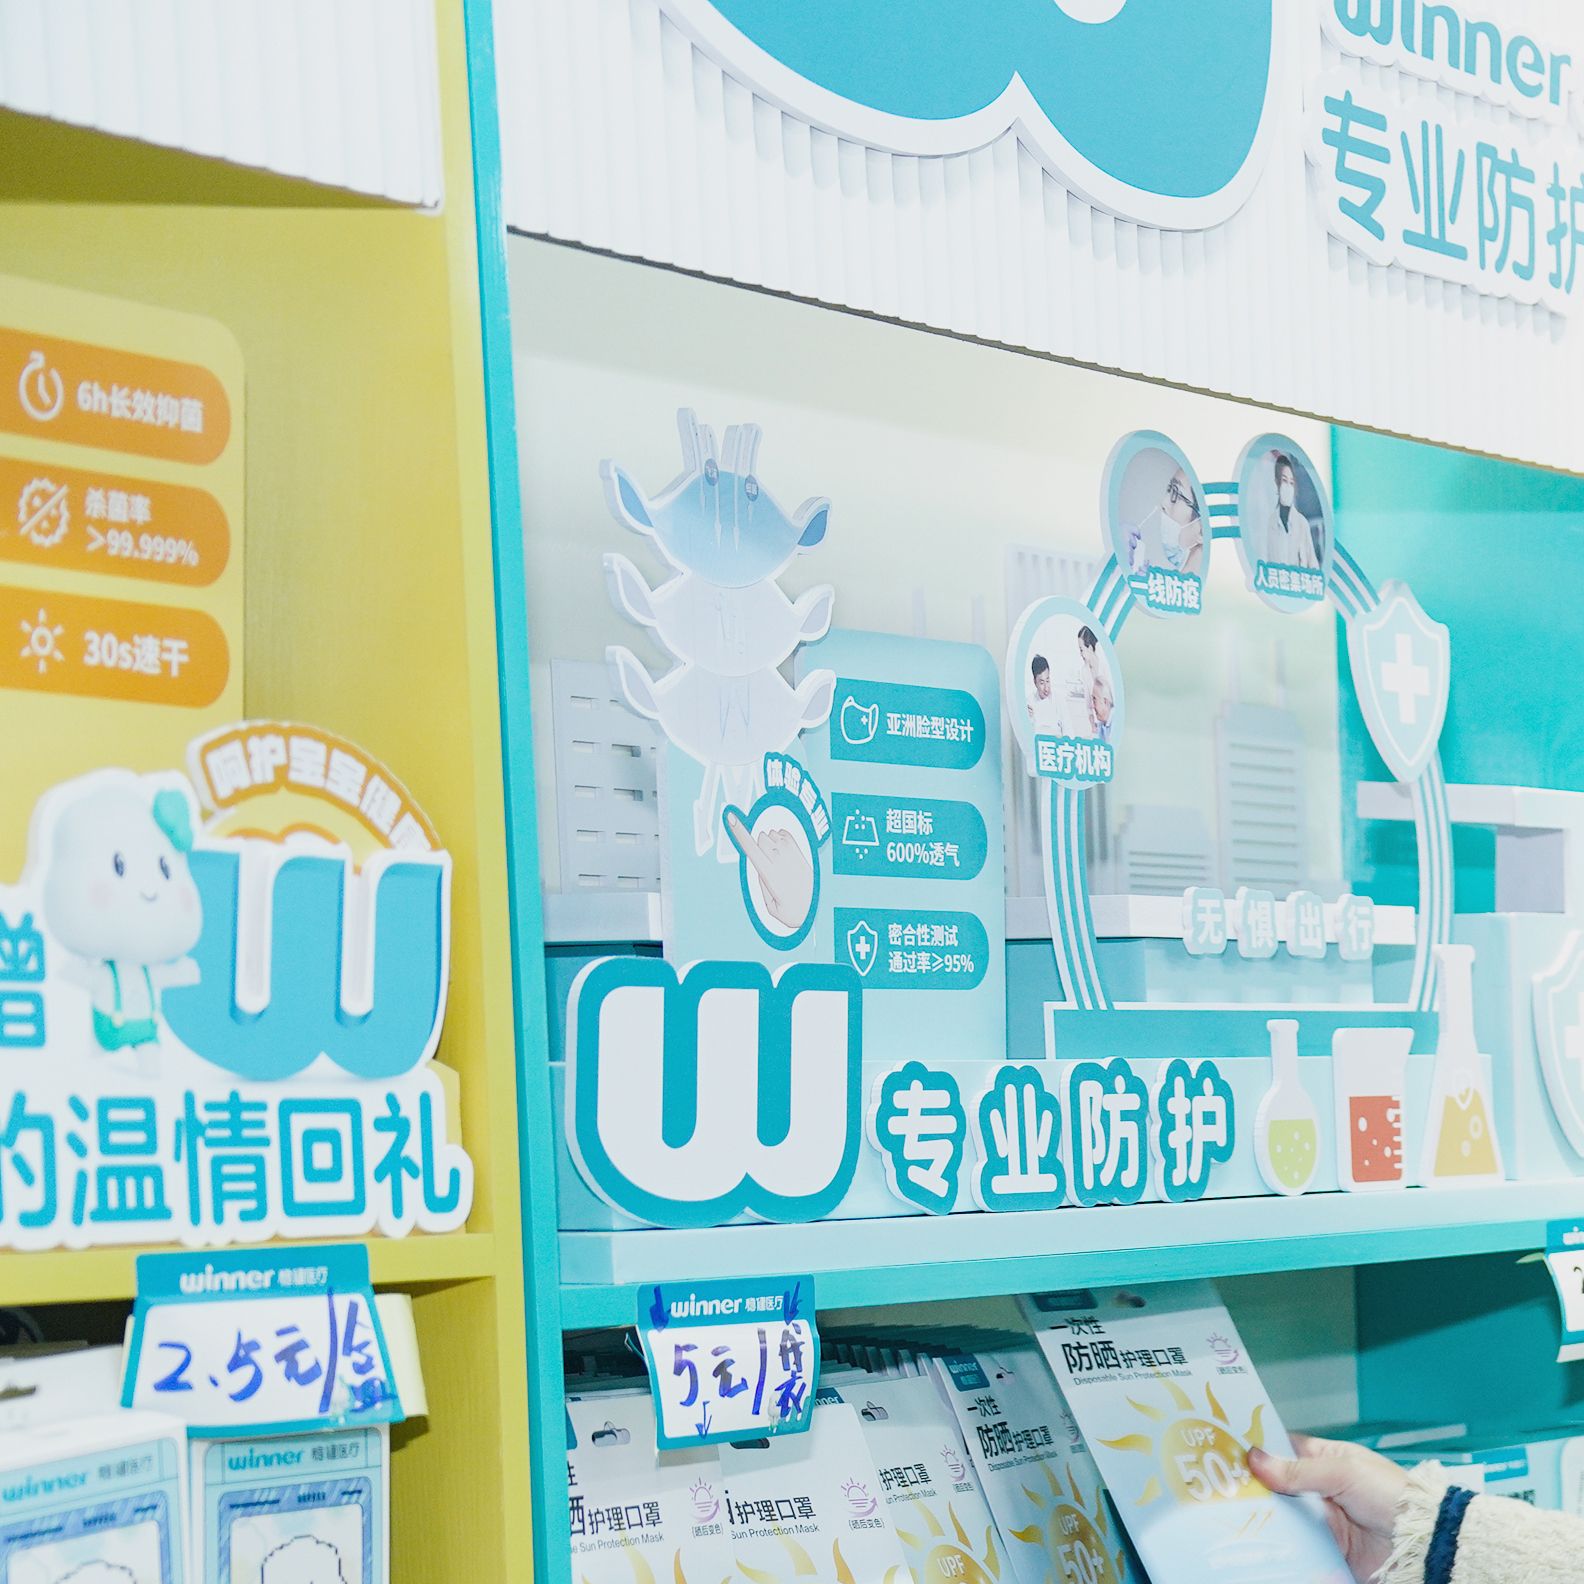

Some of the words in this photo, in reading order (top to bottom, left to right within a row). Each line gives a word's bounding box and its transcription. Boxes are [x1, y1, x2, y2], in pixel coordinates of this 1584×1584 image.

[77, 381, 203, 433] 6h长效抑菌
[1130, 573, 1200, 610] 一线防疫
[1255, 565, 1324, 597] 人员密集场所
[84, 630, 190, 678] 30s速干
[886, 713, 974, 743] 亚洲脸型设计
[1038, 740, 1112, 777] 医疗机构
[886, 808, 934, 835] 超国标
[886, 843, 961, 867] 600%透气
[888, 923, 959, 947] 密合性测试
[1197, 898, 1373, 951] 无惧出行
[888, 951, 975, 974] 通过率≥95%
[886, 1078, 1228, 1198] 专业防护
[179, 1263, 276, 1294] winner
[670, 1293, 743, 1318] winner
[1049, 1316, 1106, 1336] 一次性
[1060, 1339, 1189, 1375] 防晒护理口罩
[1073, 1373, 1118, 1386] Disposable
[1133, 1370, 1172, 1381] Protection
[1172, 1368, 1193, 1378] Mask
[967, 1395, 1002, 1417] 一次性
[976, 1422, 1055, 1460] 防晒护理口罩
[1180, 1427, 1216, 1449] UPF
[228, 1447, 307, 1472] winner
[1, 1469, 90, 1503] winner
[878, 1463, 932, 1491] 护理口罩
[749, 1525, 797, 1540] Protection
[797, 1522, 820, 1535] Mask
[1057, 1513, 1080, 1536] UPF
[579, 1539, 597, 1553] Sun
[597, 1535, 642, 1552] Protection
[641, 1532, 665, 1546] Mask
[936, 1554, 966, 1579] UPF
